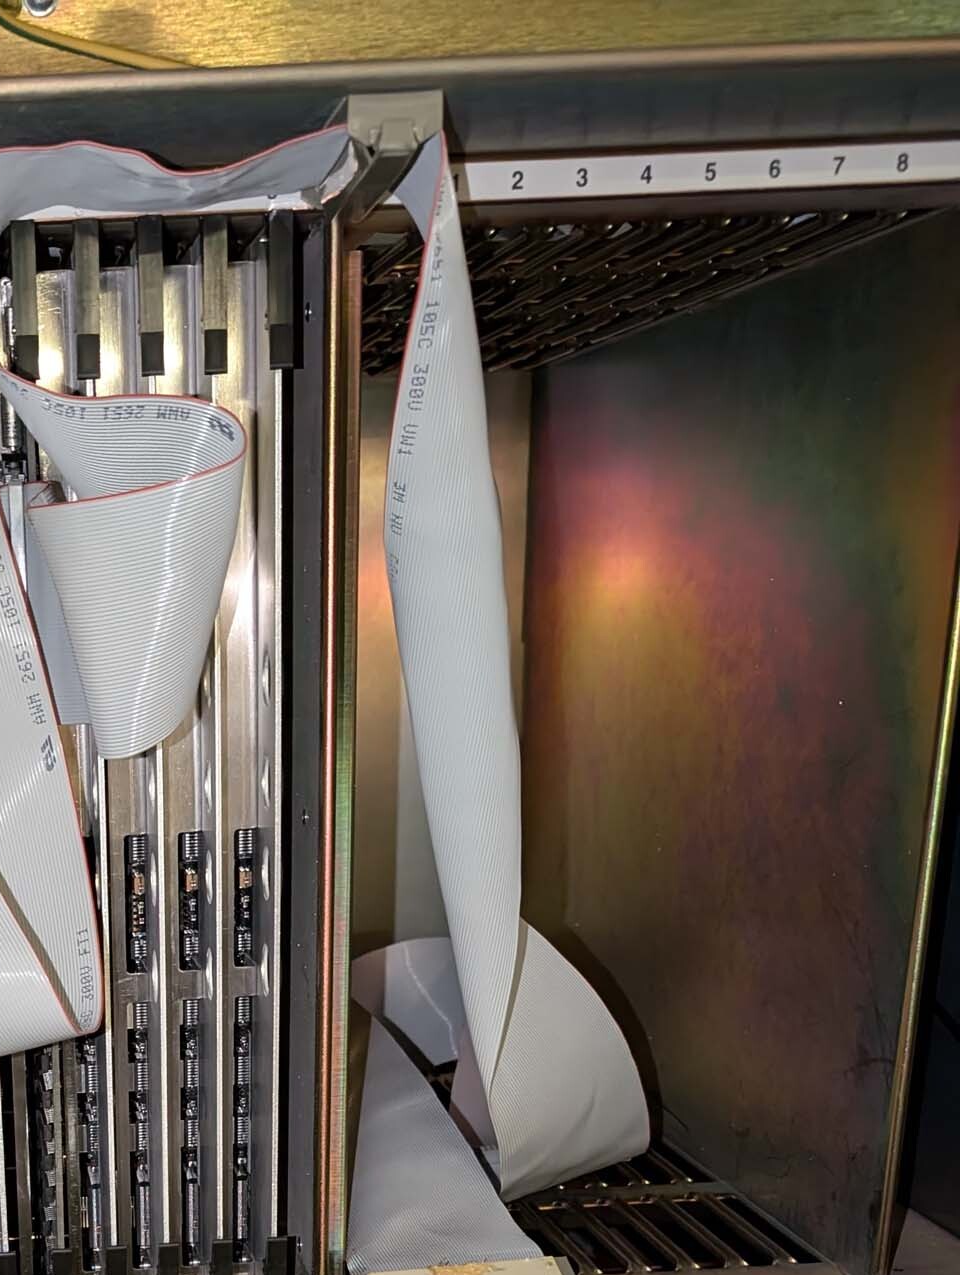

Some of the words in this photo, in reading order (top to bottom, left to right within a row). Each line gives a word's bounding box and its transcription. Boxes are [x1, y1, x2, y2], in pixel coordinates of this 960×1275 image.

[511, 170, 524, 191] 2
[575, 167, 588, 188] 3
[640, 164, 653, 185] 4
[704, 161, 717, 182] 5
[768, 159, 781, 179] 6
[833, 155, 846, 175] 7
[896, 152, 909, 173] 8
